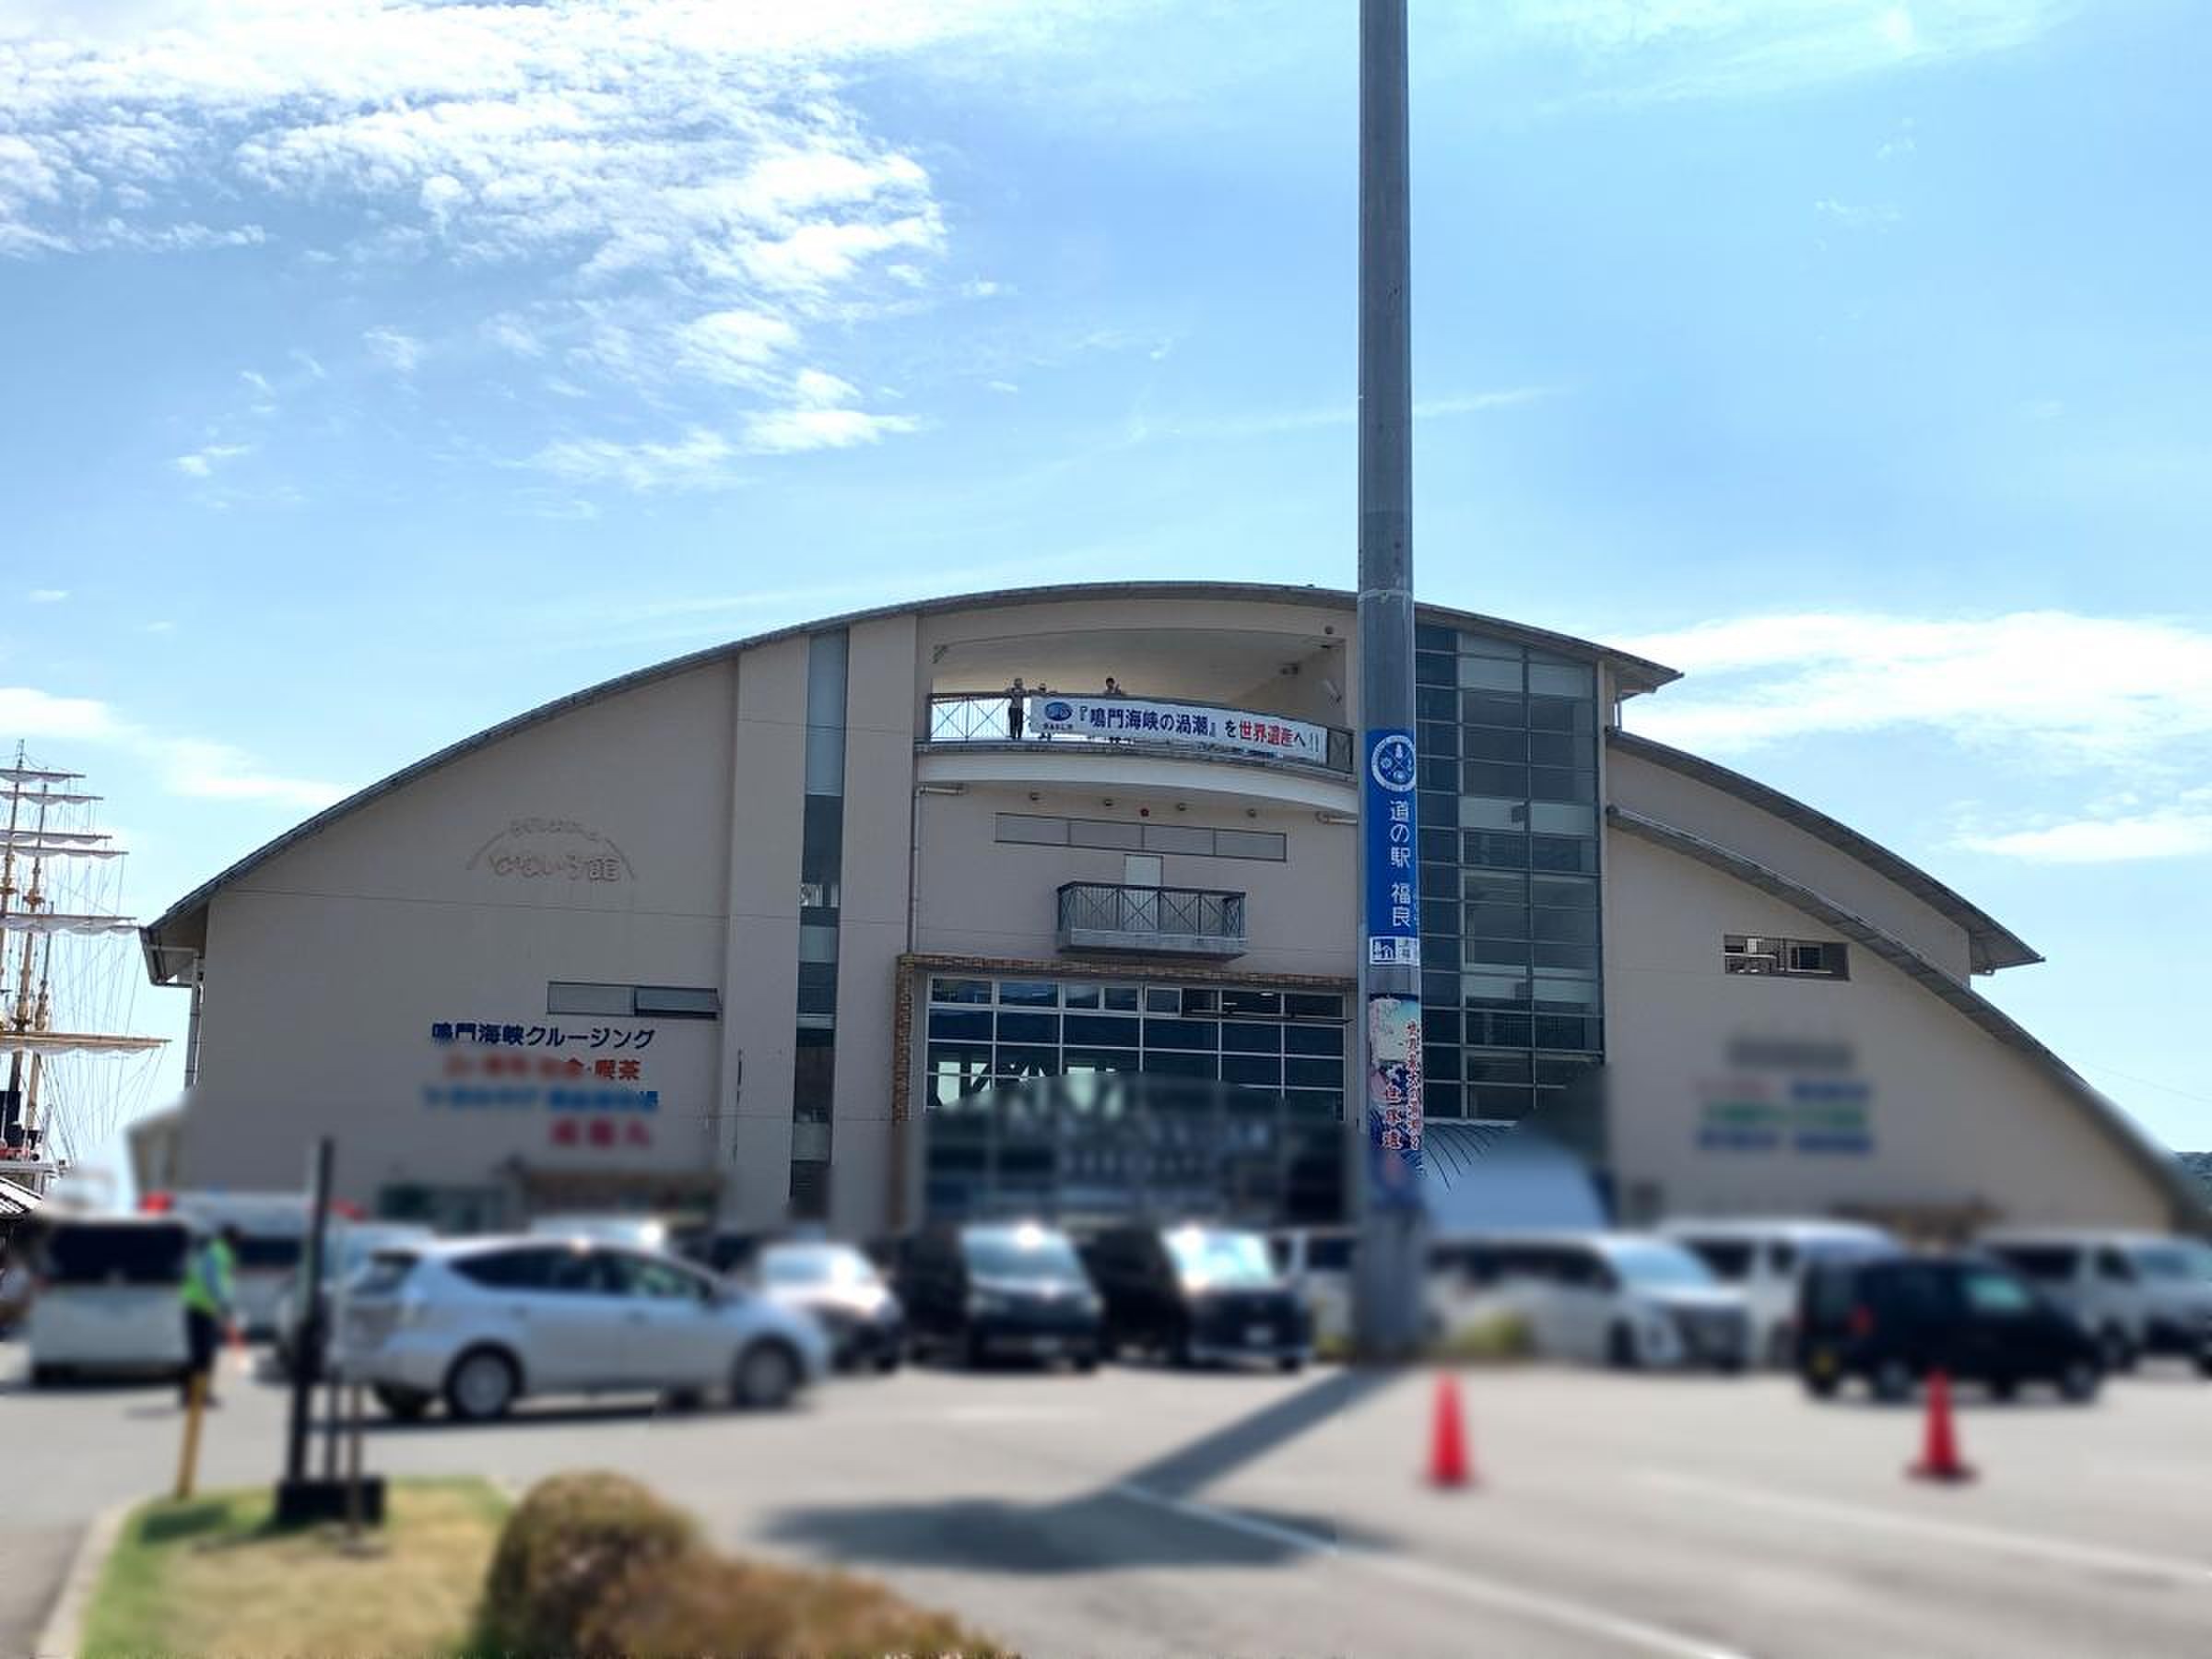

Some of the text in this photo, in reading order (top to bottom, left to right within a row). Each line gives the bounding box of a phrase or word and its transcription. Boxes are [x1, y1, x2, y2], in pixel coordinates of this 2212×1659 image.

[1389, 800, 1412, 927] 道の駅 福良
[431, 1022, 655, 1050] 鳴門海峡クルージング
